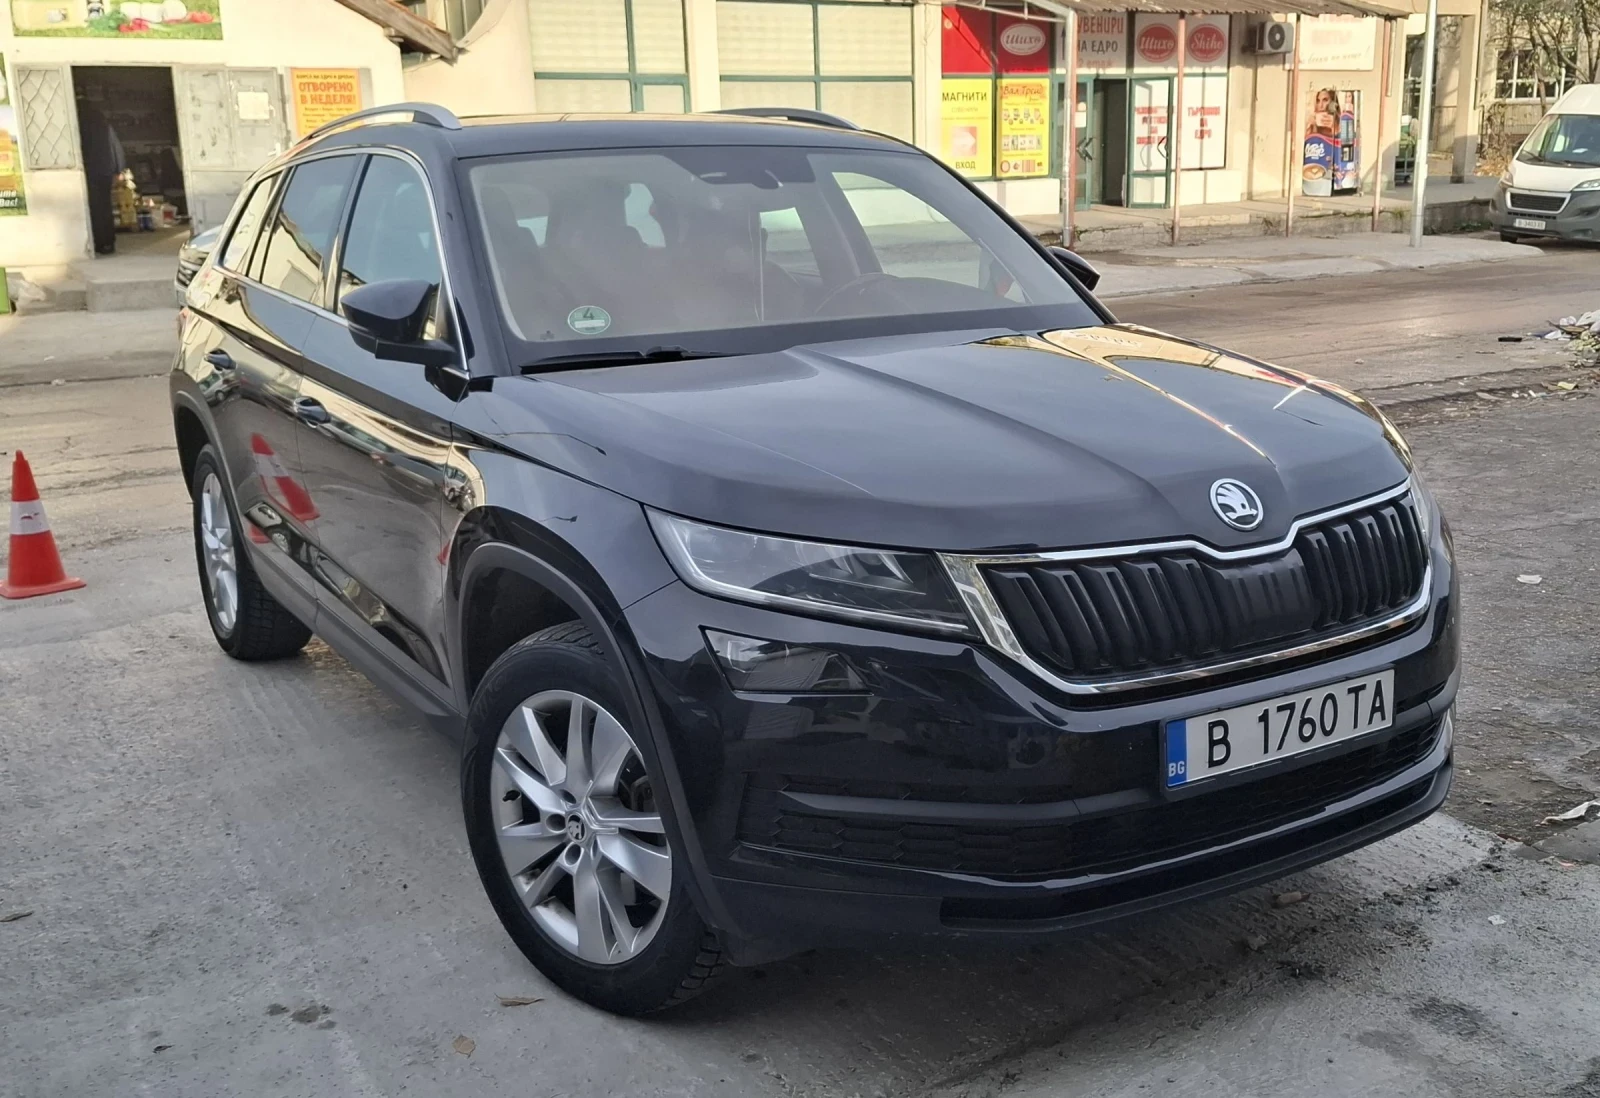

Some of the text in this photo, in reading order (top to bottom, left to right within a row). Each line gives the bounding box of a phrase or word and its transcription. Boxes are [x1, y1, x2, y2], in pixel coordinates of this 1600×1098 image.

[1077, 15, 1124, 34] УВЕНИРИ
[1091, 40, 1119, 54] ЕДРО
[299, 82, 353, 93] ОТВОРЕНО
[300, 94, 357, 105] В НЕДЕЛЯ!
[942, 92, 988, 102] МАГНИТИ
[955, 161, 976, 170] ВХОД
[583, 307, 595, 320] 4
[1207, 679, 1386, 768] B 1760 TA
[1168, 761, 1185, 777] BG
